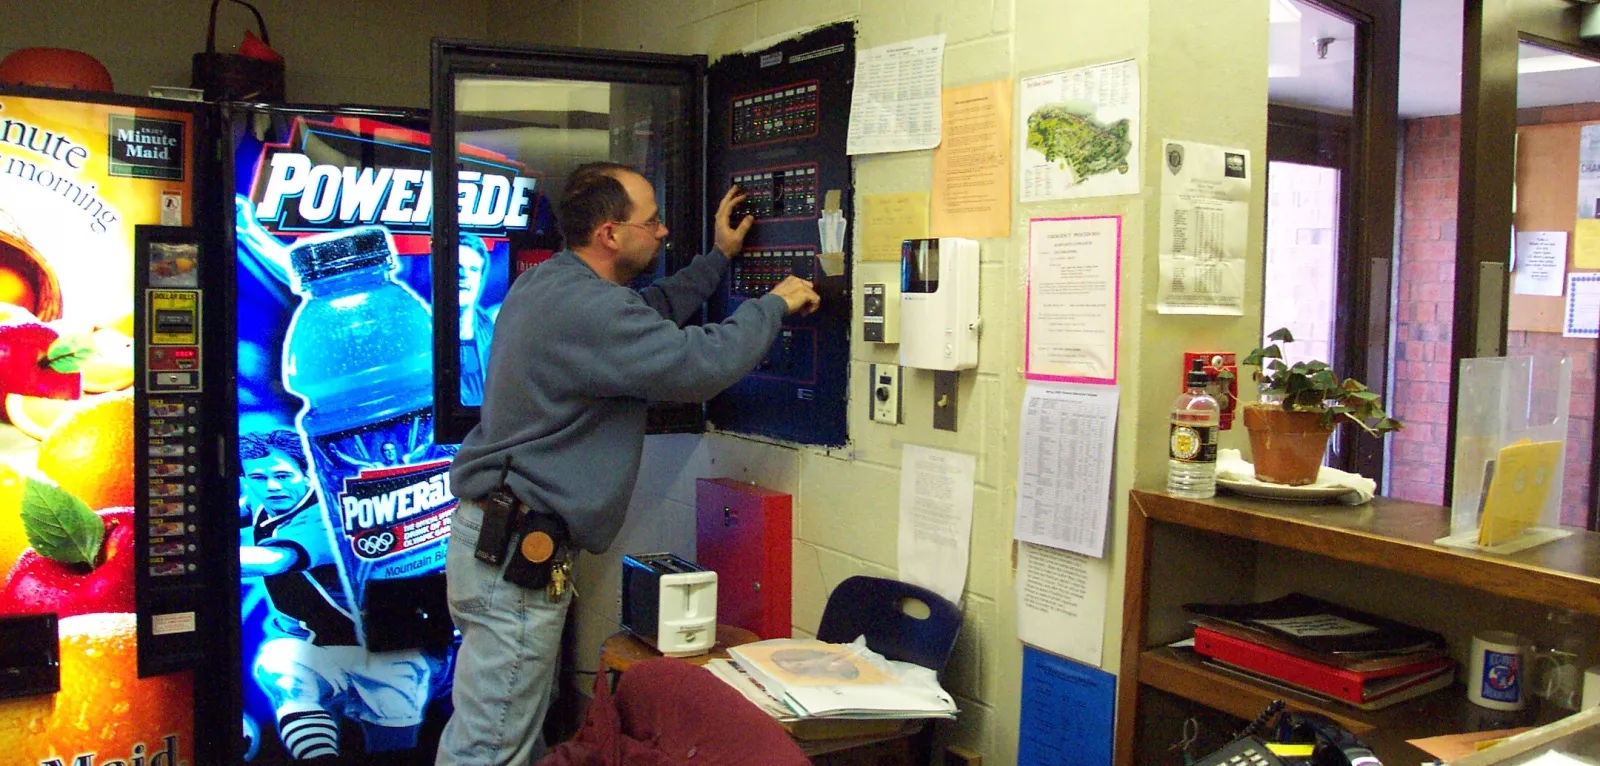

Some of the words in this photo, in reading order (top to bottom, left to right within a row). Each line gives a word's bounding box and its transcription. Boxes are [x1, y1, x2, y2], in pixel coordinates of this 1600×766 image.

[117, 128, 178, 147] Minute
[141, 127, 164, 135] ENJOY
[0, 119, 88, 169] nute
[126, 144, 169, 160] Maid
[5, 158, 117, 233] morning
[384, 556, 432, 578] Mountain
